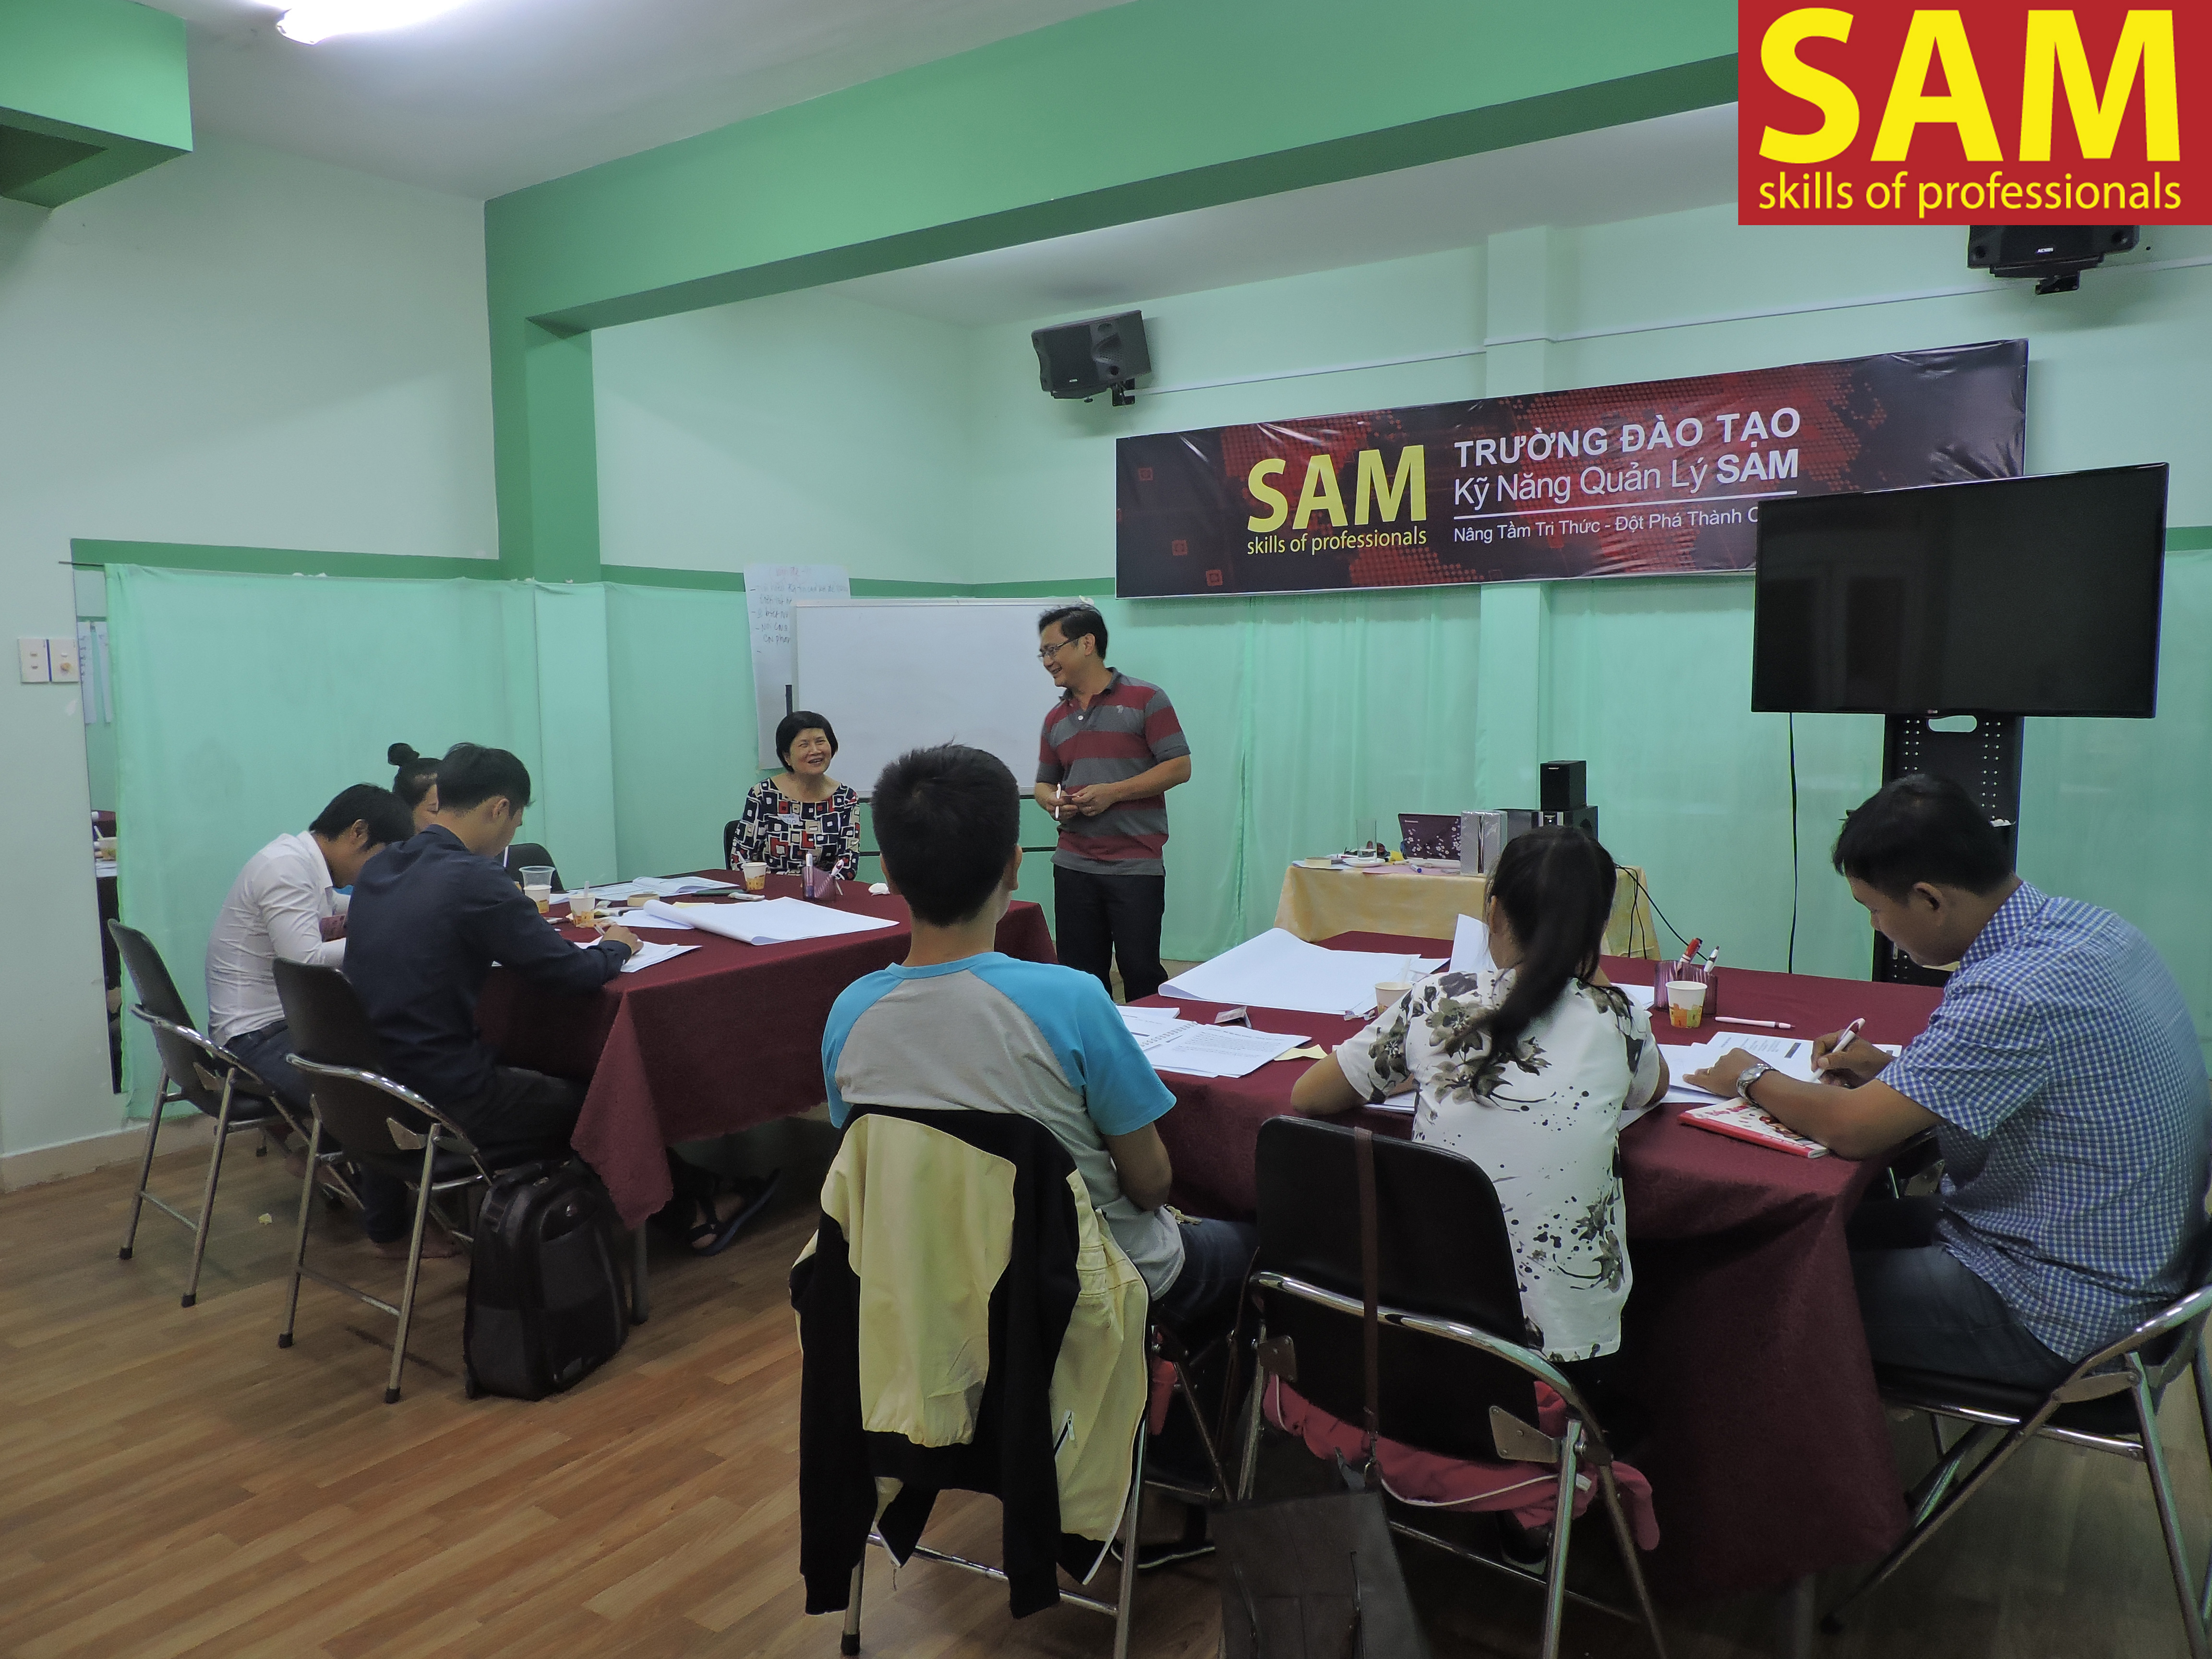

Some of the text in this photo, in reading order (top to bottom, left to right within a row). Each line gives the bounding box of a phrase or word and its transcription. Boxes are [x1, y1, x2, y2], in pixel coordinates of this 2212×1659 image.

[1454, 407, 1800, 468] TRƯỜNG ĐÀO TẠO
[1248, 445, 1427, 533] SAM
[1454, 448, 1798, 510] Kỹ Năng Quản Lý SAM
[1247, 525, 1427, 555] skills of professionals
[1454, 527, 1493, 543] Nâng
[1497, 521, 1530, 539] Tầm
[1535, 521, 1554, 536] Tri
[1558, 518, 1600, 535] Thức
[1615, 516, 1644, 533] Đột
[1649, 512, 1682, 529] Phá
[1687, 508, 1742, 526] Thành
